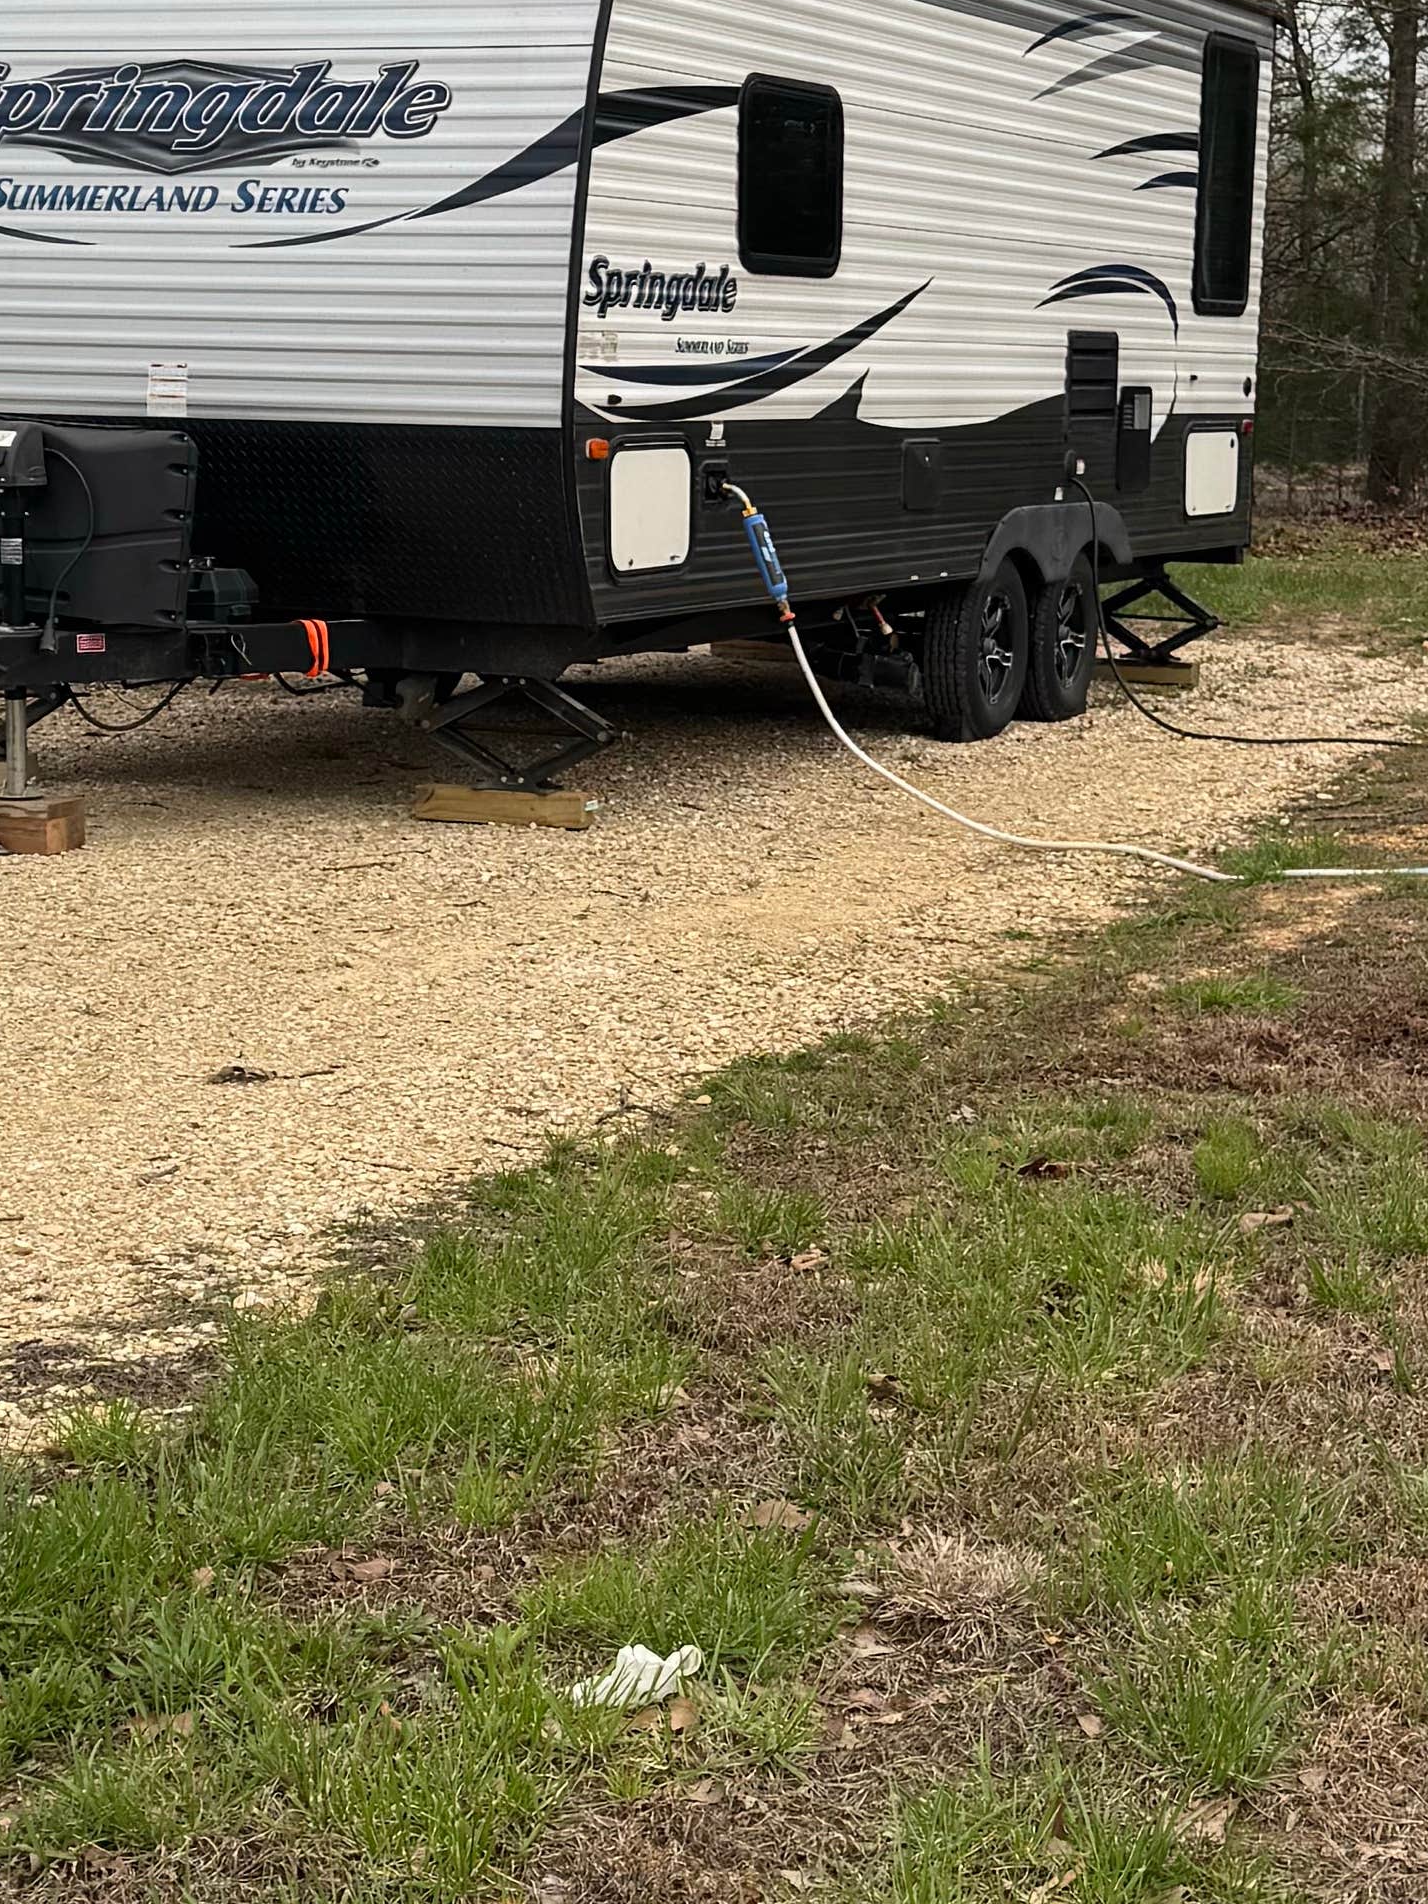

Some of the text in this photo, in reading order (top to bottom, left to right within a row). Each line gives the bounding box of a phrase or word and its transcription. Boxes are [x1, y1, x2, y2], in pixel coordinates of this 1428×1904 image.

[291, 158, 360, 168] by Keystone
[230, 179, 349, 214] SERIES
[582, 254, 737, 321] Springdale
